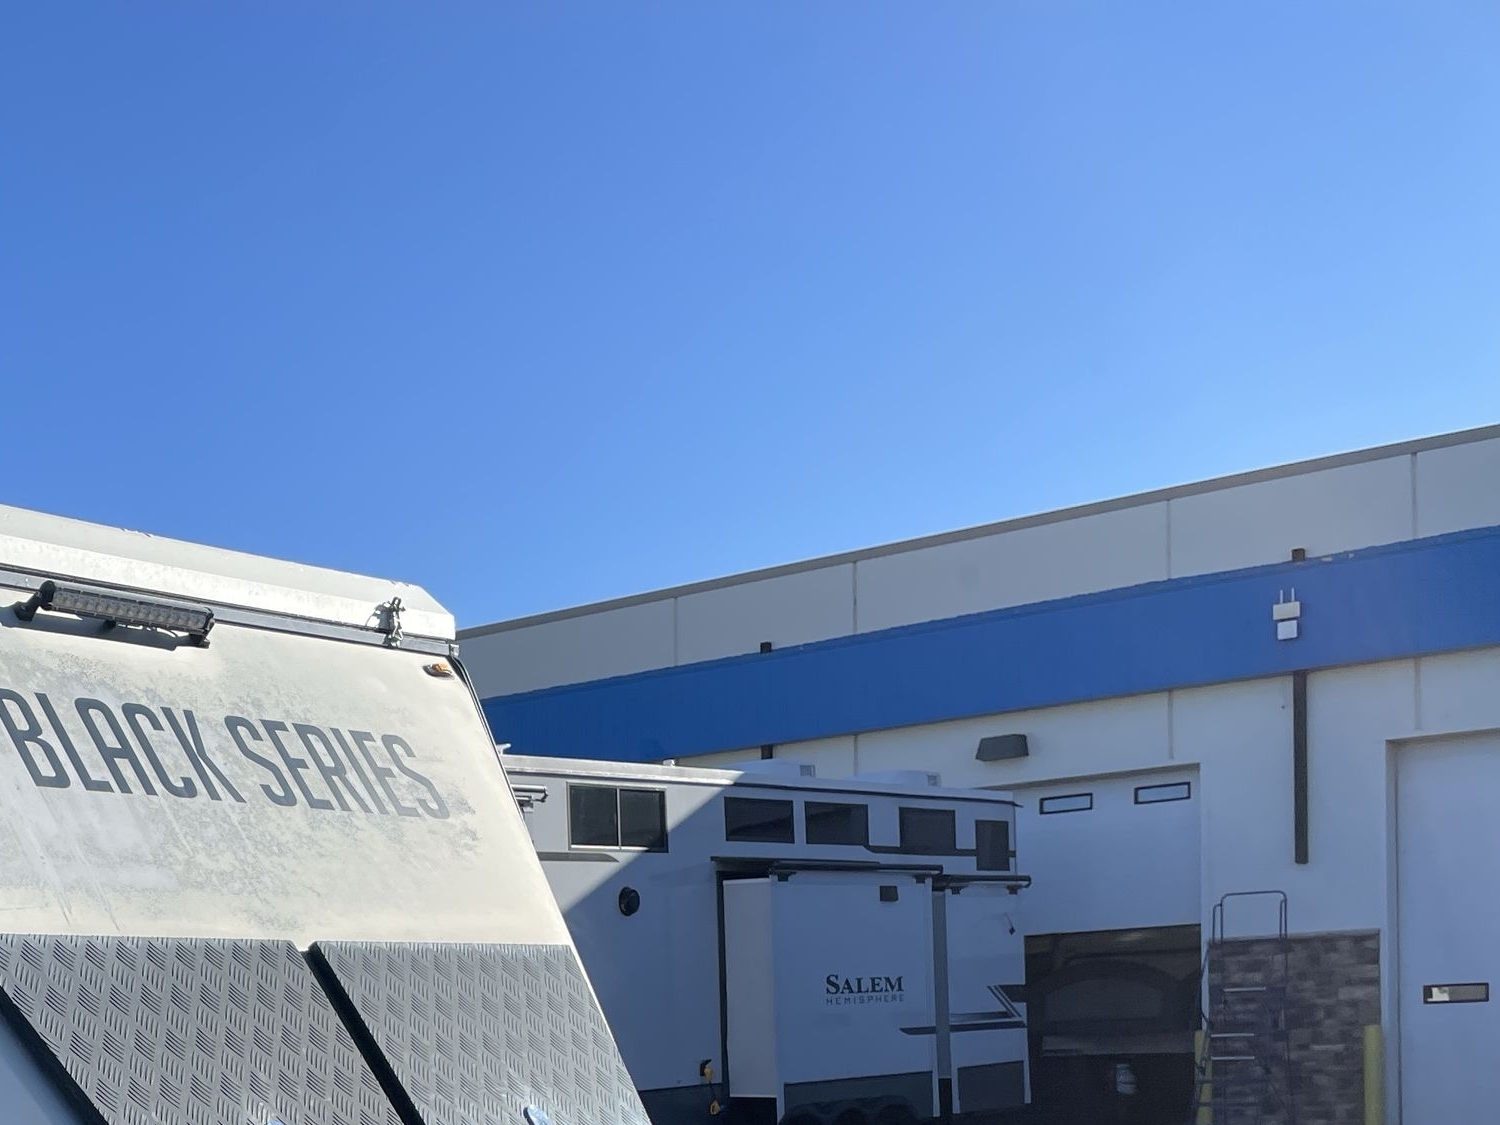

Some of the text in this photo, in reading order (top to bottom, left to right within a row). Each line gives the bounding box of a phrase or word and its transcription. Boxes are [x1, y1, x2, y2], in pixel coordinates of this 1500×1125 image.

[225, 715, 450, 820] SERIES
[826, 974, 904, 994] SALEM
[826, 994, 904, 1006] HEMISPHERE
